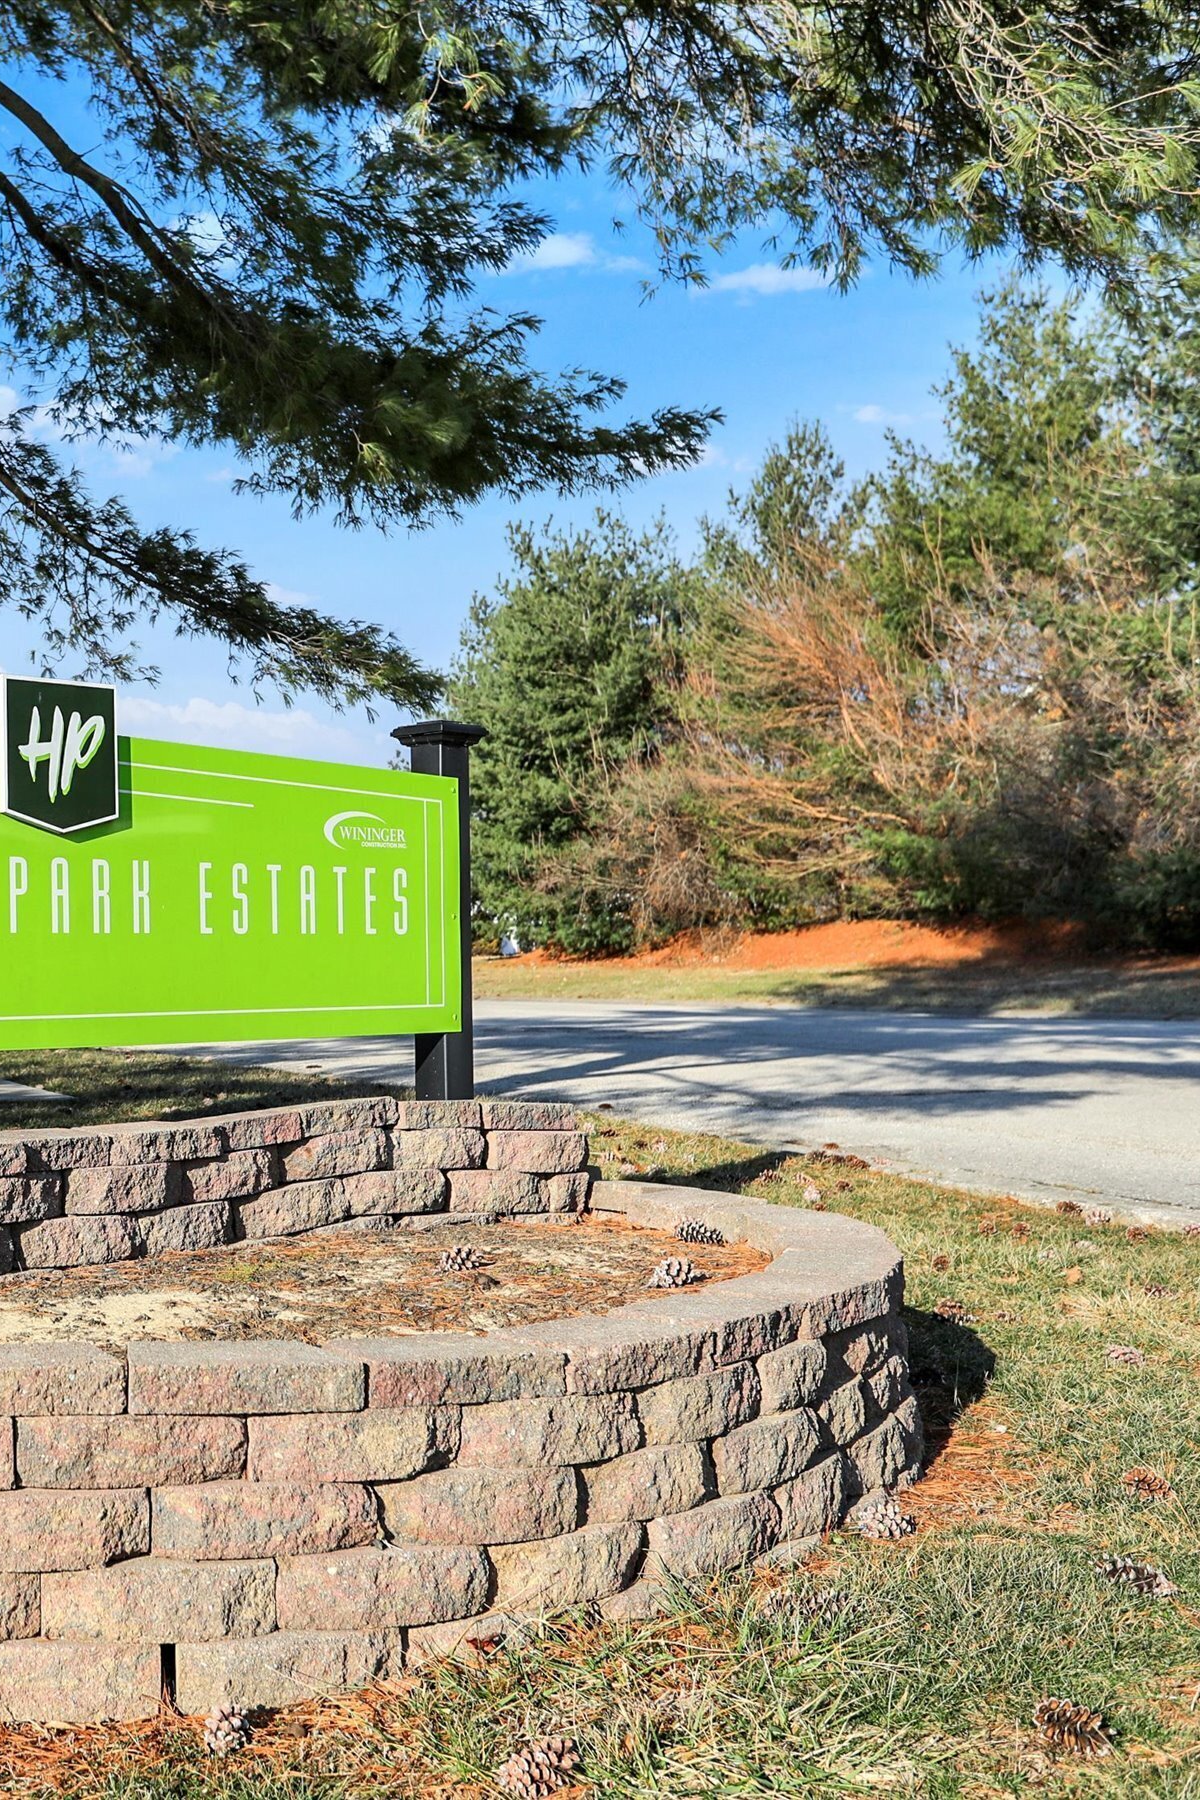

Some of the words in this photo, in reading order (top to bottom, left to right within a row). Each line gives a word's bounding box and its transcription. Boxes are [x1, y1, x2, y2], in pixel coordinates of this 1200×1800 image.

[18, 705, 105, 803] HP
[339, 826, 405, 842] WININGER
[8, 856, 150, 934] PARK
[200, 862, 408, 935] ESTATES
